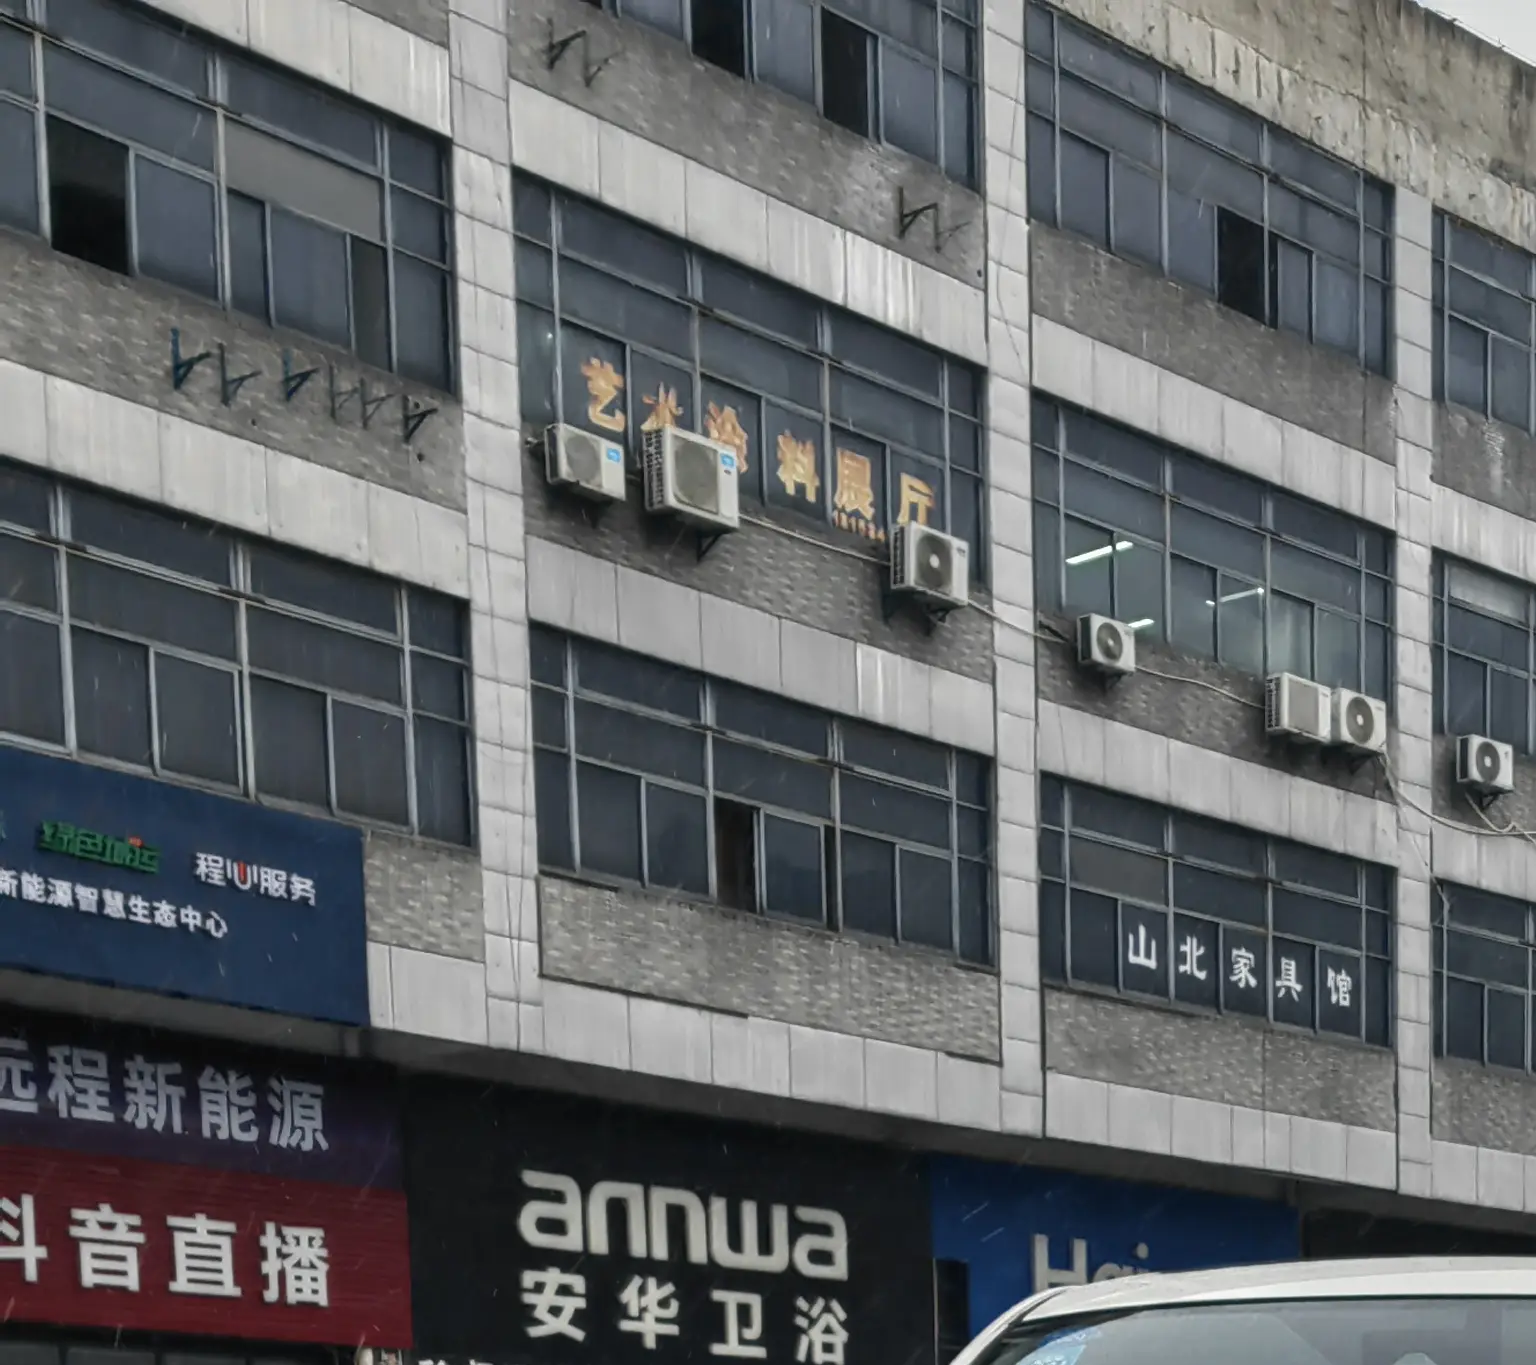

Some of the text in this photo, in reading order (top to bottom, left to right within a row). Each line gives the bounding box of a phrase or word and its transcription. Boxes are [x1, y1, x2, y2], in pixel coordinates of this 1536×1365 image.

[0, 867, 229, 940] 新能源智慧生态中心
[1127, 924, 1352, 1008] 山北家具馆
[0, 1037, 329, 1152] 远程新能源
[517, 1169, 848, 1281] annwa
